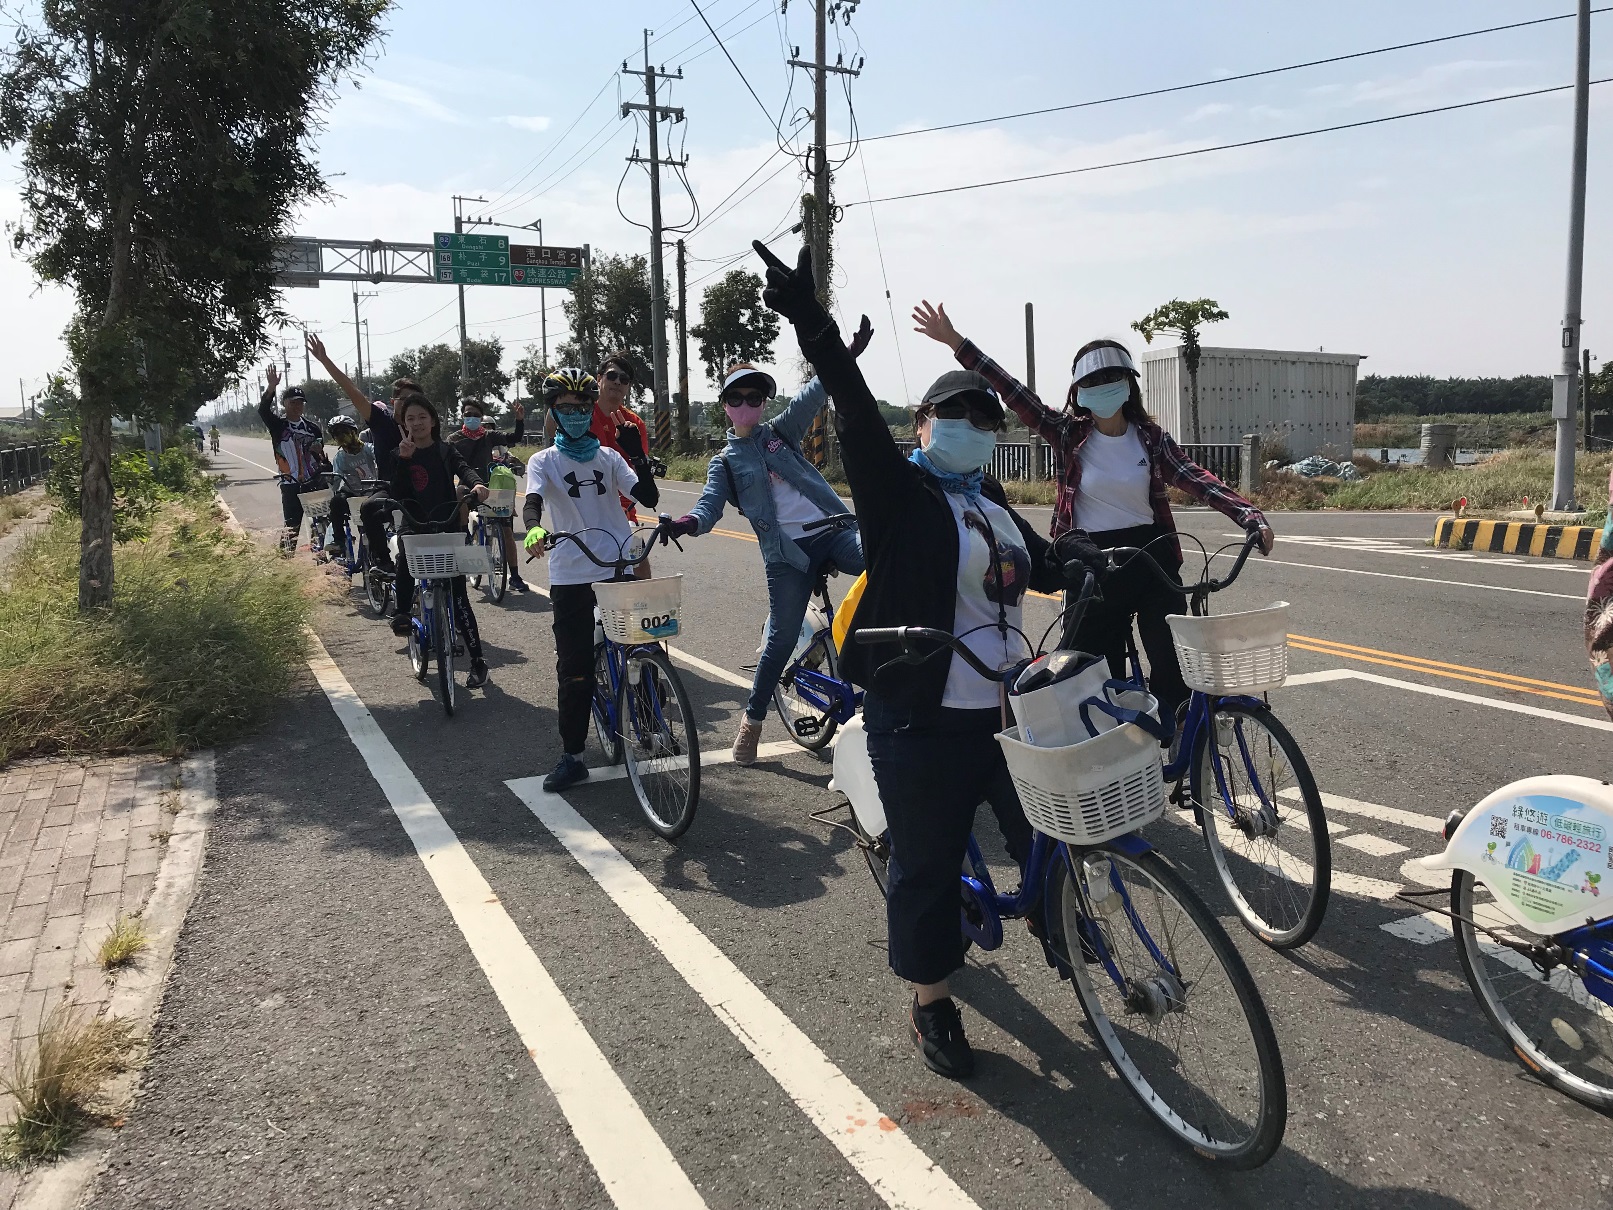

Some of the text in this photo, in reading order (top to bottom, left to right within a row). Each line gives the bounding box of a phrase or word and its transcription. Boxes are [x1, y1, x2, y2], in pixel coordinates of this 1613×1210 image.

[458, 235, 487, 244] 東石
[498, 239, 505, 249] 8
[440, 253, 451, 261] 168
[458, 252, 487, 261] 朴子
[526, 248, 566, 260] 港口宮
[570, 253, 577, 263] 2
[498, 256, 506, 266] 9
[460, 269, 489, 277] 布袋
[494, 273, 507, 282] 17
[527, 268, 566, 278] 快速公路
[641, 614, 670, 630] 002
[1512, 804, 1548, 826] 綠悠遊
[1540, 829, 1602, 853] 06-786-2322
